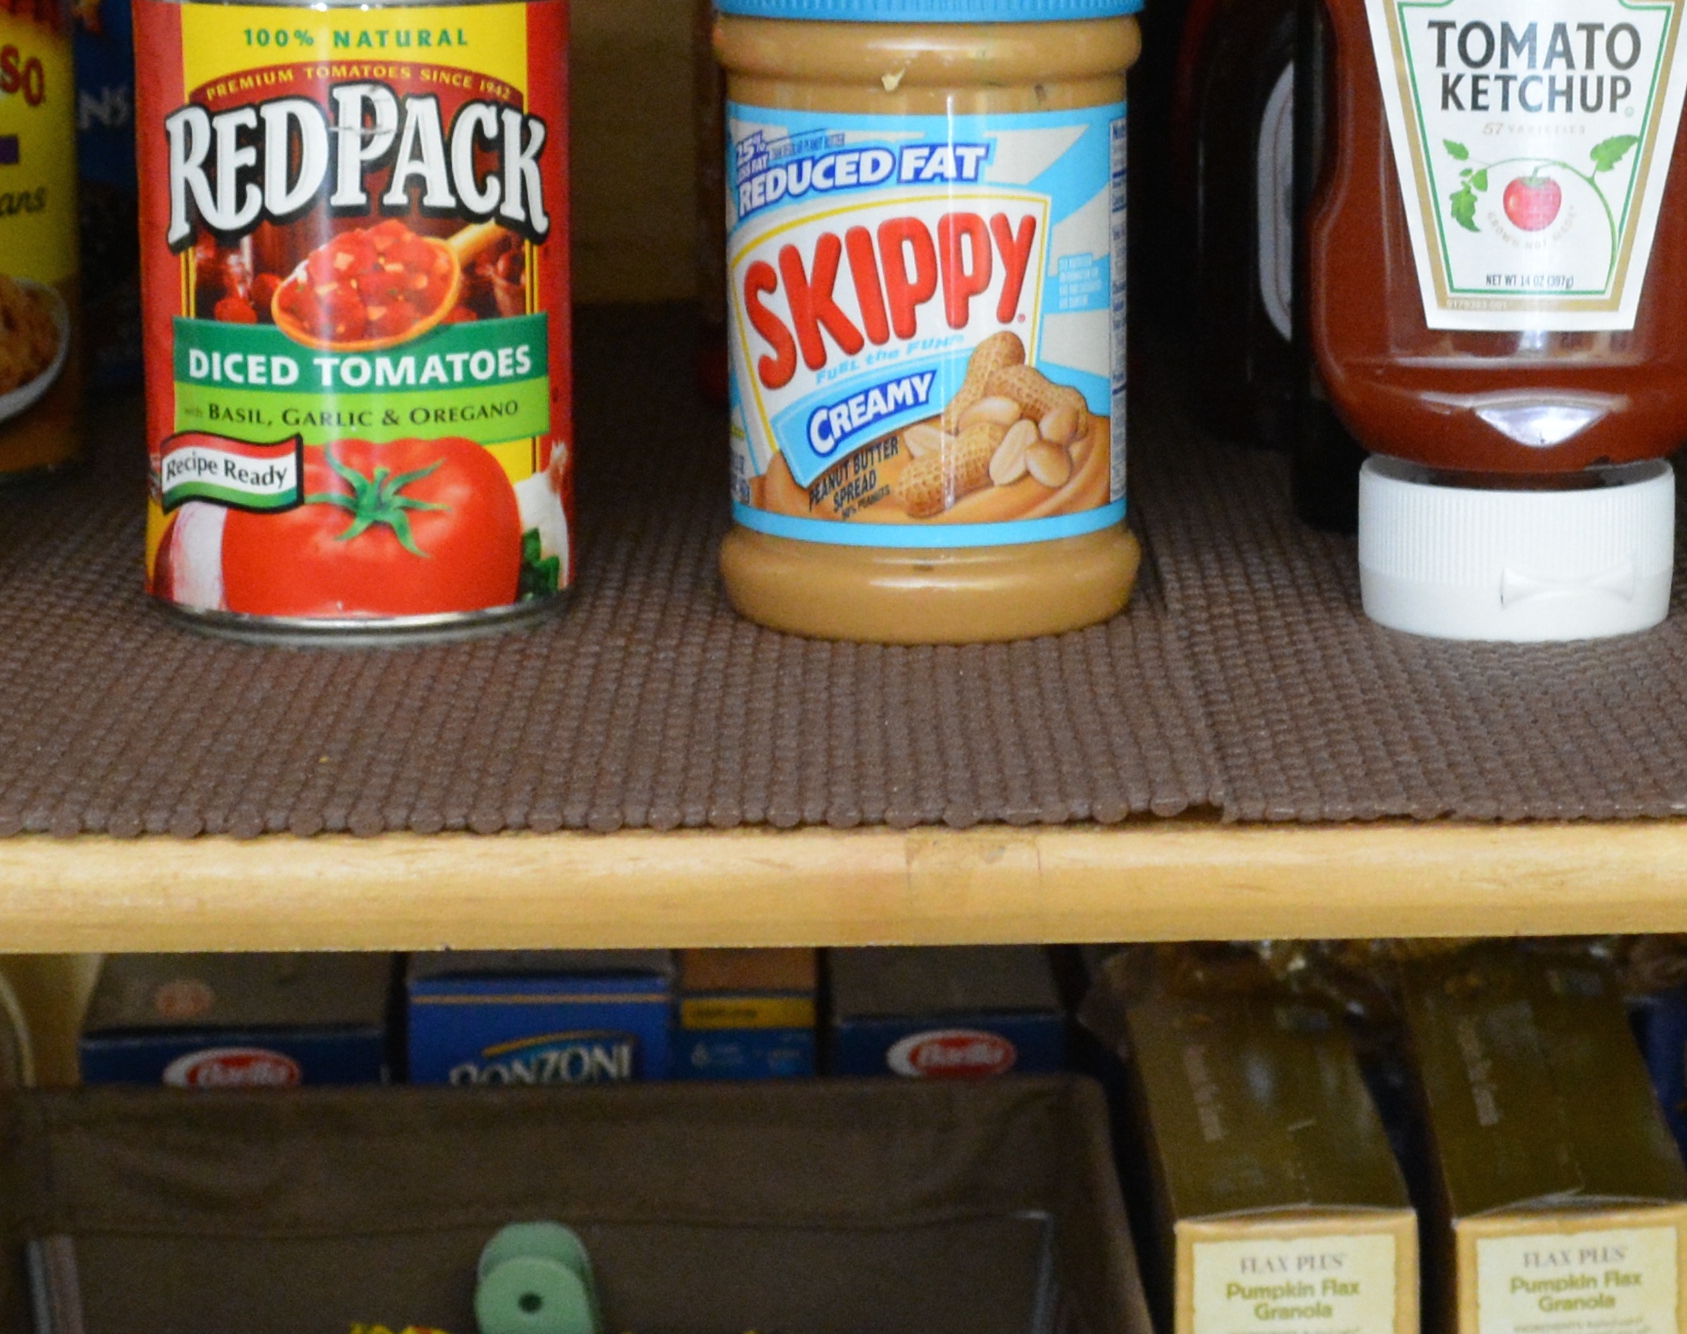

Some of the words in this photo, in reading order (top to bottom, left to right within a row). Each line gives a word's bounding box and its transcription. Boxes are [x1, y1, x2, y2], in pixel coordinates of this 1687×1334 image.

[244, 29, 315, 48] 100%
[334, 27, 468, 48] NATURAL
[1427, 19, 1641, 71] TOMATO
[207, 68, 294, 101] PREMIUM
[305, 64, 410, 79] TOMATOES
[420, 68, 472, 89] SINCE
[480, 80, 511, 100] 1942
[1441, 73, 1632, 114] KETCHUP
[739, 148, 894, 218] REDUCED
[900, 145, 988, 181] FAT
[1486, 274, 1502, 286] NET
[1504, 274, 1517, 286] WT
[743, 212, 1037, 390] SKIPPY
[189, 349, 298, 385] DICED
[314, 344, 531, 387] TOMATOES
[815, 359, 861, 385] FUEL
[865, 348, 901, 365] the
[208, 405, 273, 427] BASIL,
[282, 408, 372, 427] GARLIC
[382, 408, 400, 426] &
[409, 399, 519, 426] OREGANO
[809, 371, 933, 455] CREAMY
[165, 451, 218, 483] Recipe
[223, 457, 287, 489] Ready
[809, 462, 849, 512] PEANUT
[853, 435, 899, 475] BUTTER
[833, 469, 877, 513] SPREAD
[1239, 1255, 1291, 1275] FLAX
[1509, 1274, 1598, 1294] Pumpkin
[1603, 1270, 1643, 1287] Flax
[1226, 1280, 1315, 1301] Pumpkin
[1321, 1278, 1360, 1297] Flax
[1538, 1293, 1616, 1313] Granola
[1253, 1302, 1334, 1322] Granola
